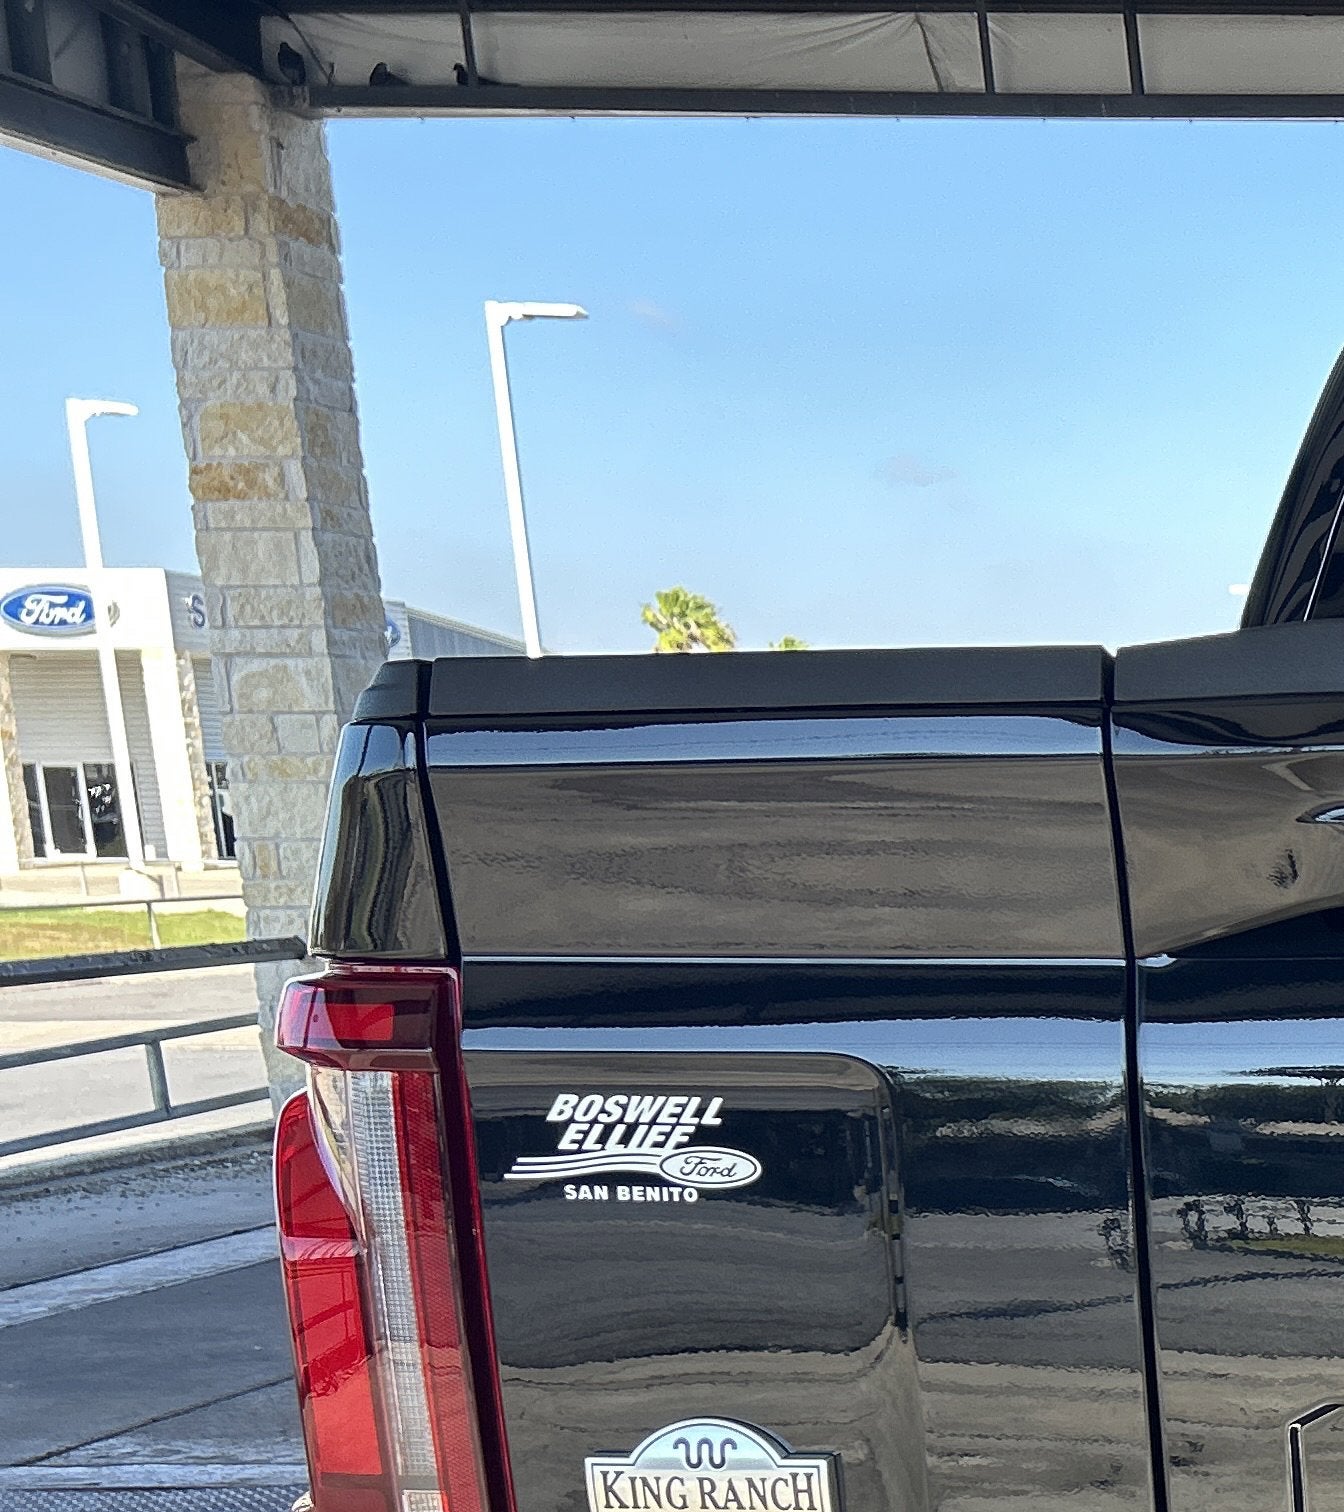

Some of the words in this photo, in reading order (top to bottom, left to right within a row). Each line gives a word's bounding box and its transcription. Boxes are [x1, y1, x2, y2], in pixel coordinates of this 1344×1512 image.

[20, 594, 86, 625] Ford
[545, 1093, 724, 1126] BOSWELL
[557, 1123, 696, 1150] ELLIFF
[679, 1155, 738, 1178] Ford
[564, 1184, 609, 1201] SAN
[617, 1186, 698, 1202] BENITO
[600, 1470, 689, 1510] KING
[696, 1472, 818, 1510] RANCH
